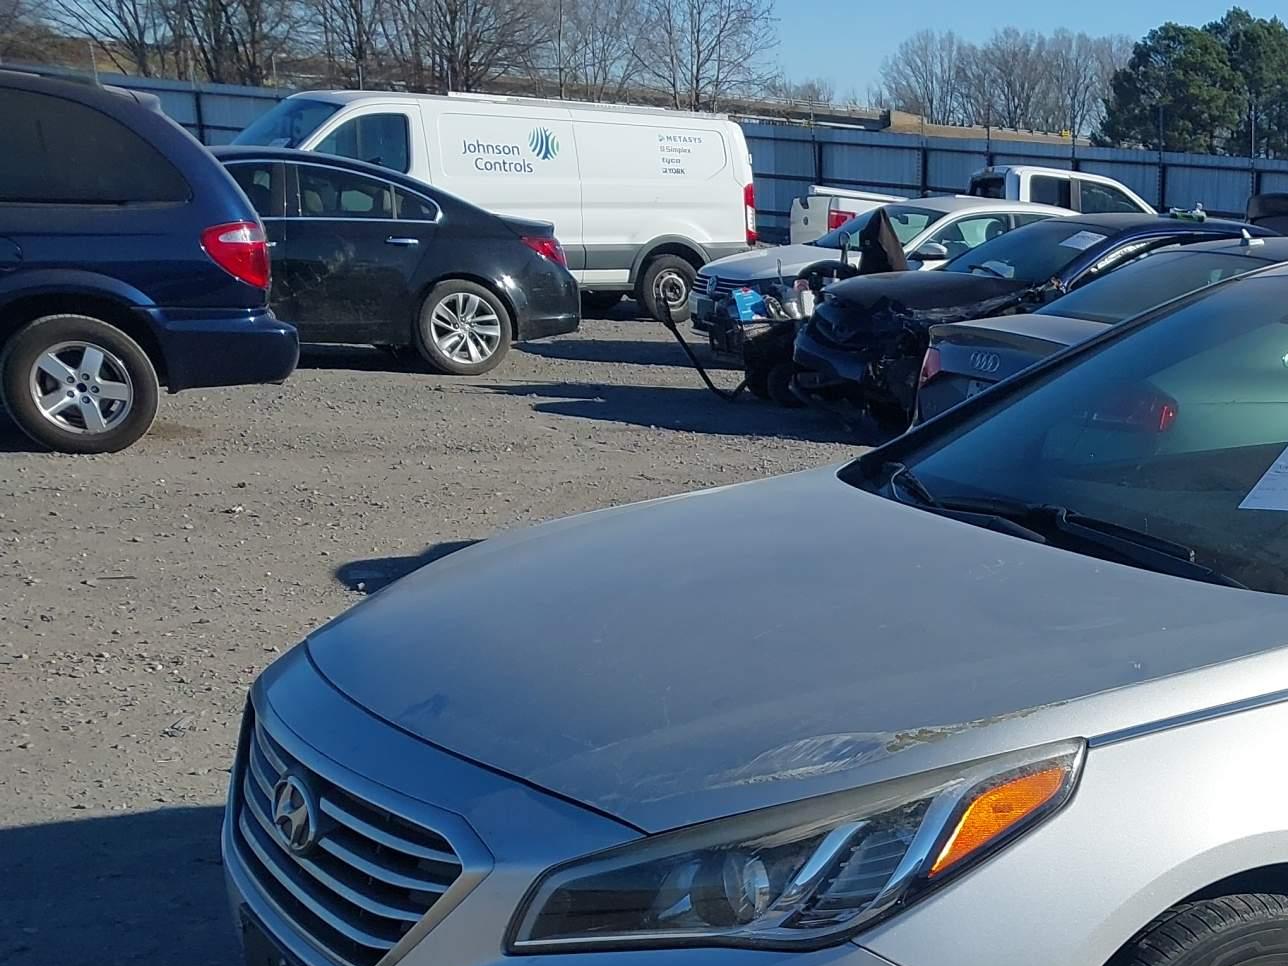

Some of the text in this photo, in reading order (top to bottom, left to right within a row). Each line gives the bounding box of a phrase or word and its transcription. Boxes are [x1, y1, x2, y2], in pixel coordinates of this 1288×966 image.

[462, 139, 520, 155] Johnson
[666, 135, 702, 143] METASYS
[475, 157, 534, 173] Controls
